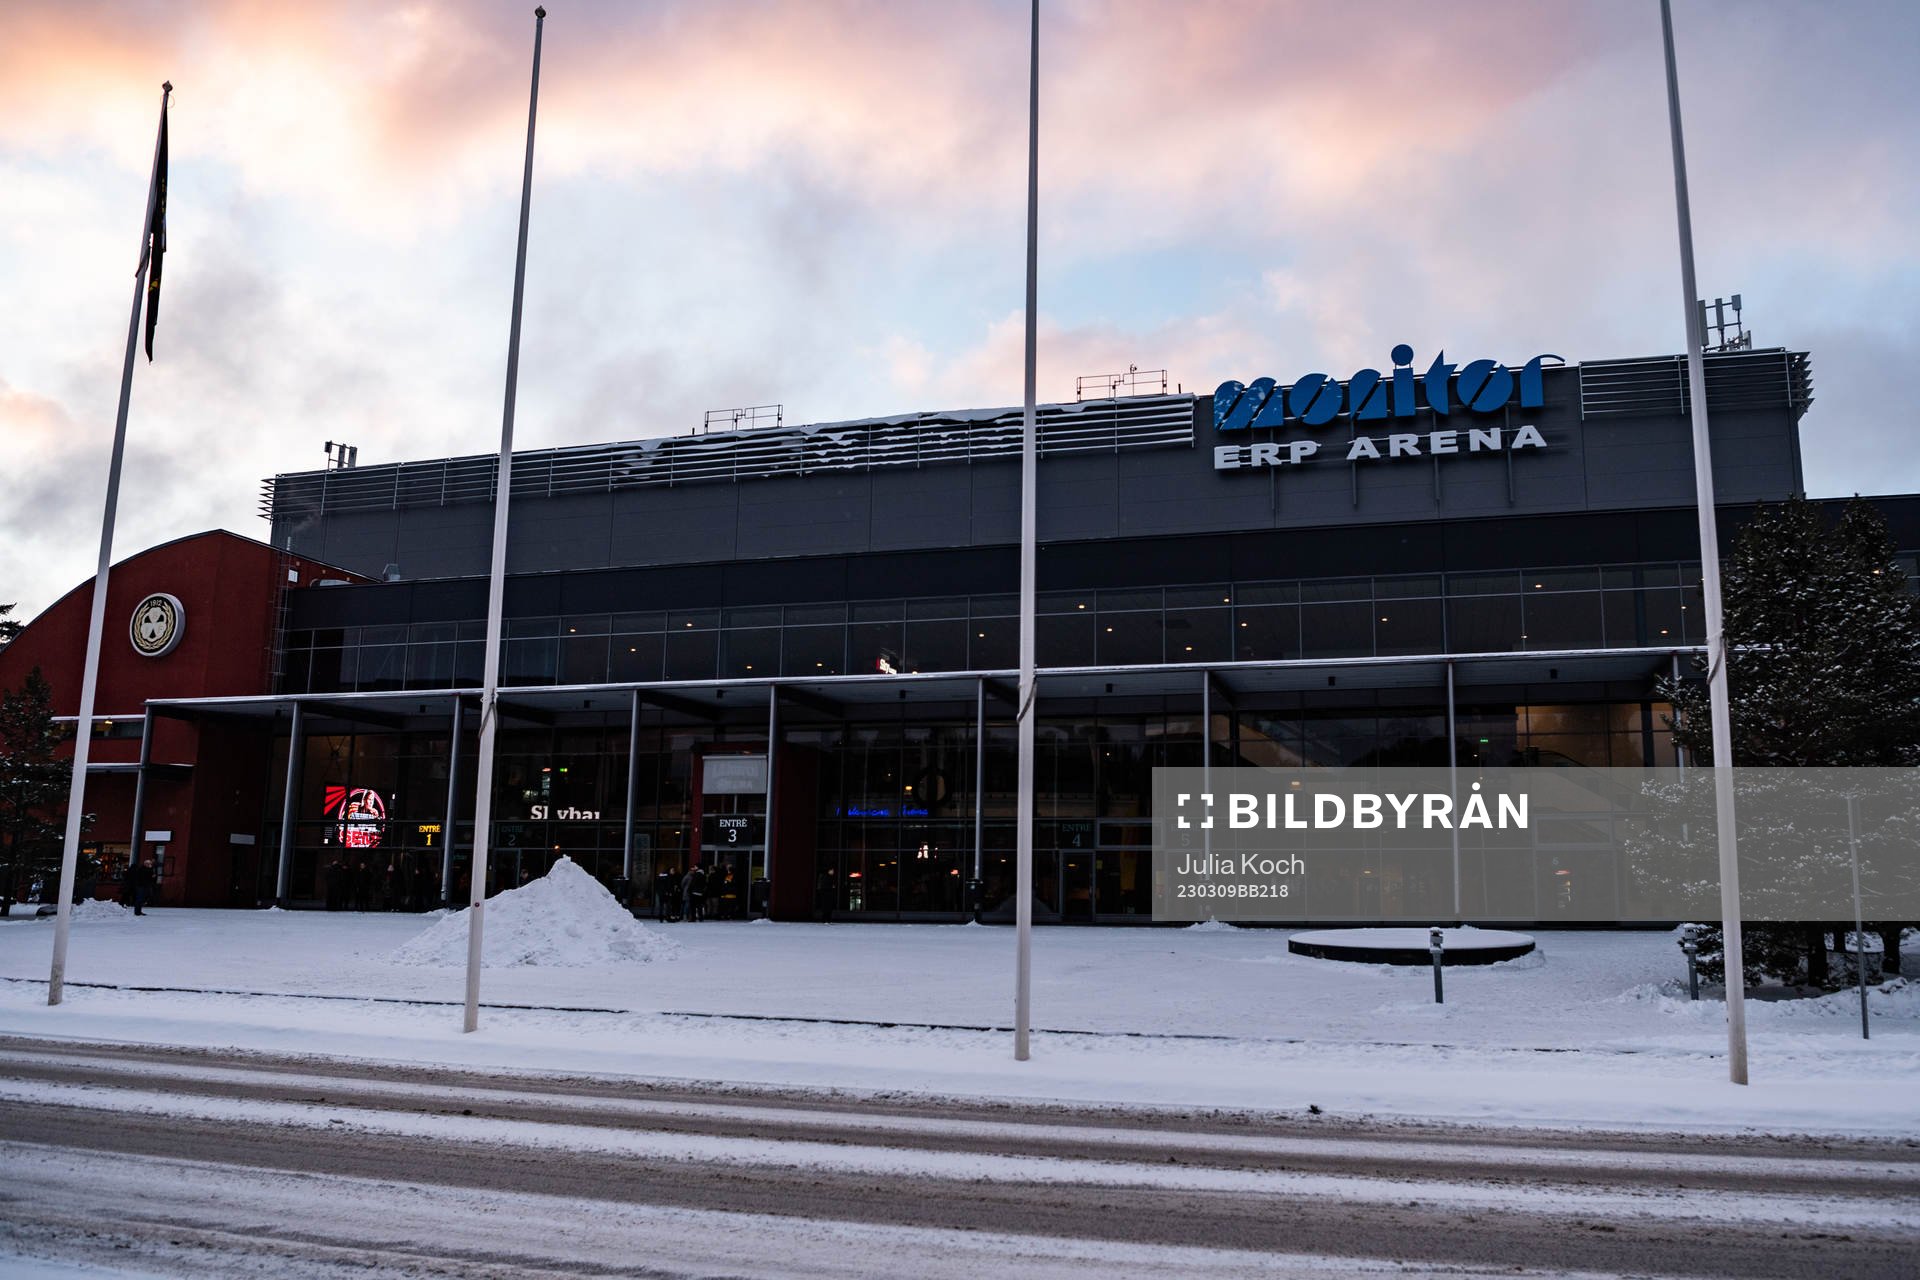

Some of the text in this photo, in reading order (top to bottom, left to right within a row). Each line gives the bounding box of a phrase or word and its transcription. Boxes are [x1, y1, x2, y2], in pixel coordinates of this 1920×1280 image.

[1214, 425, 1548, 470] ERP ARENA
[418, 824, 441, 833] ENTRÉ
[719, 817, 748, 828] ENTRÉ
[426, 833, 432, 846] 1
[727, 828, 737, 843] 3
[1072, 833, 1081, 847] 4
